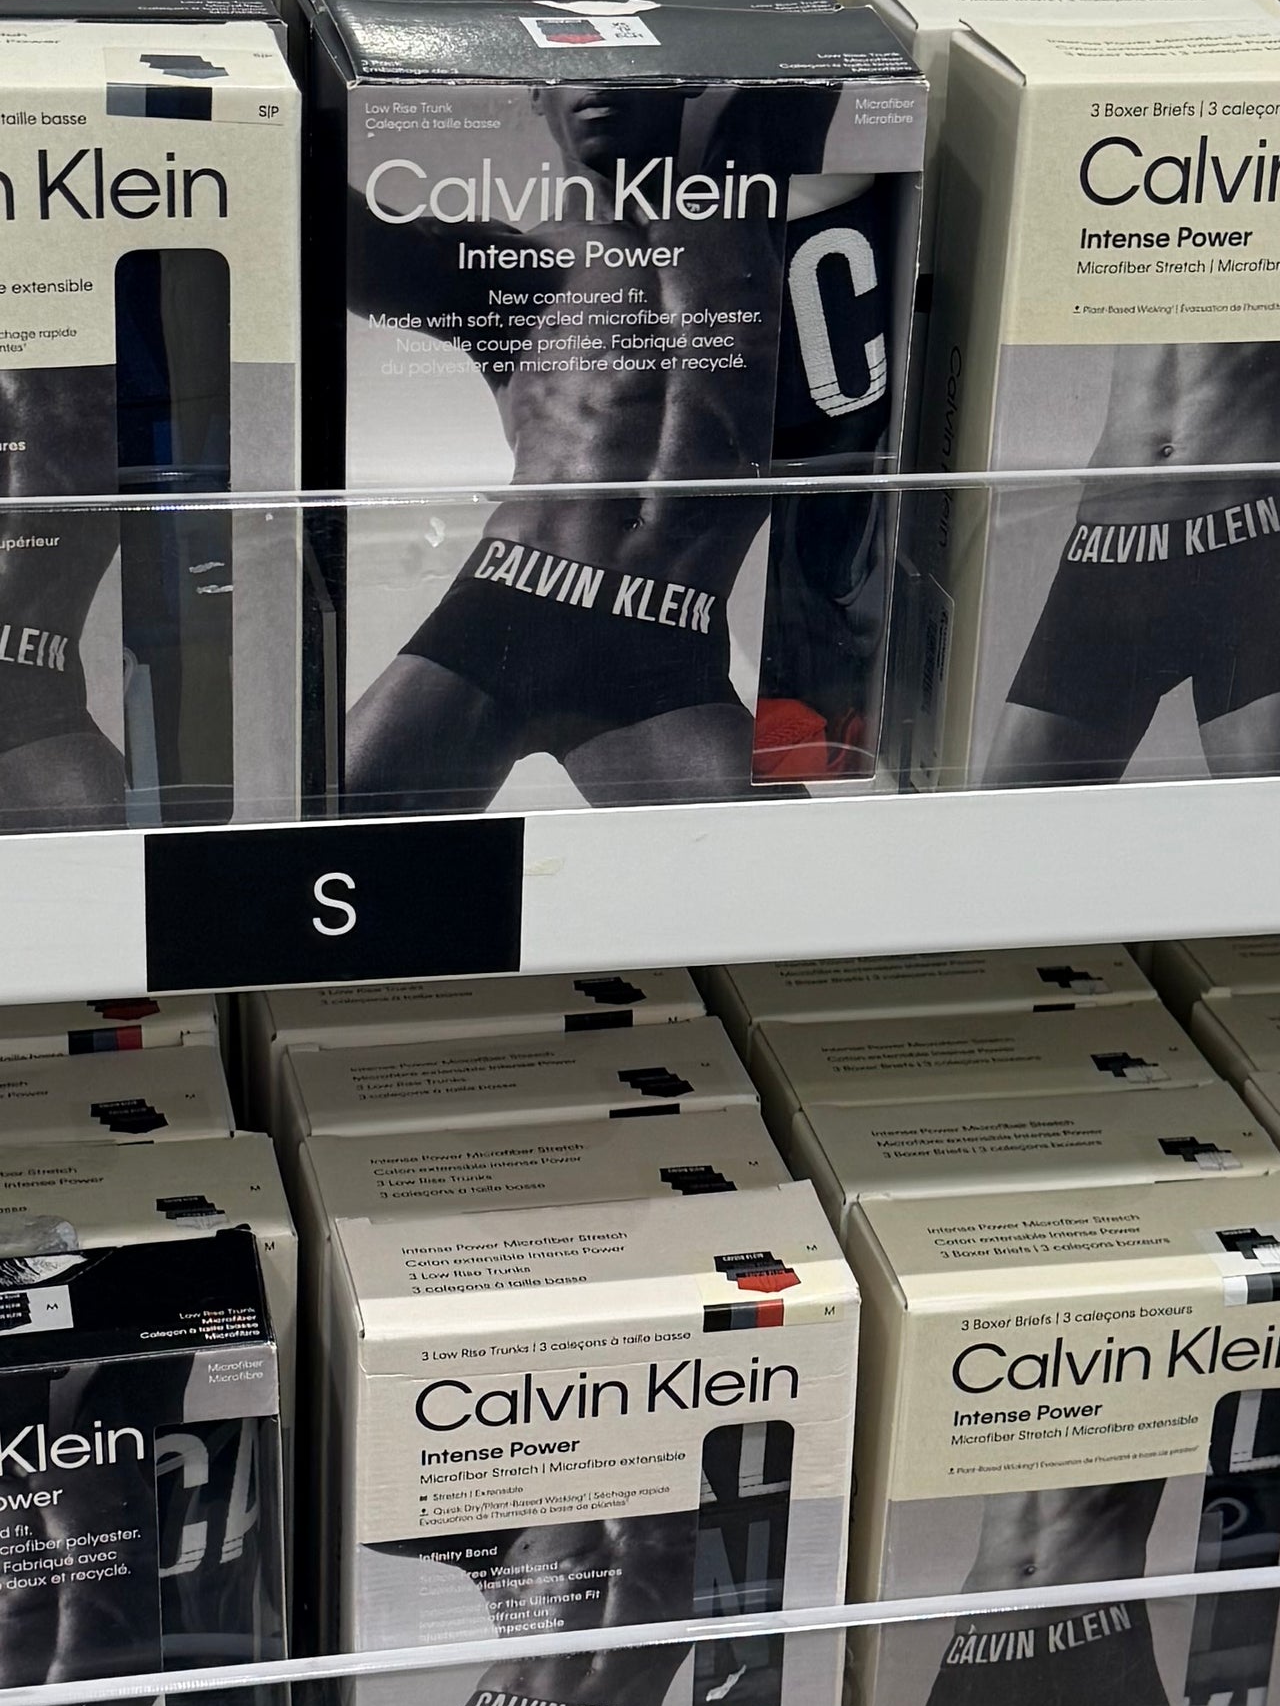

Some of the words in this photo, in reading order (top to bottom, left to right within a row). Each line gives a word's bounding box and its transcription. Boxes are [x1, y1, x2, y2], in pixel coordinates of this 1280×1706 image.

[1, 112, 37, 125] taille
[41, 112, 86, 125] basse
[1091, 103, 1100, 117] 3
[1105, 103, 1149, 117] Boxer
[1153, 102, 1195, 116] Briefs
[1208, 102, 1217, 115] 3
[38, 148, 227, 220] Klein
[366, 158, 596, 225] Calvin
[614, 157, 777, 223] Klein
[458, 242, 576, 270] Intense
[585, 240, 685, 268] Power
[1080, 227, 1171, 250] Intense
[1176, 226, 1254, 248] Power
[12, 279, 93, 294] extensible
[475, 537, 602, 608] CALVIN
[612, 575, 715, 634] KLEIN
[313, 873, 356, 935] S
[952, 1337, 1151, 1393] Calvin
[416, 1372, 628, 1431] Calvin
[648, 1357, 798, 1412] Klein
